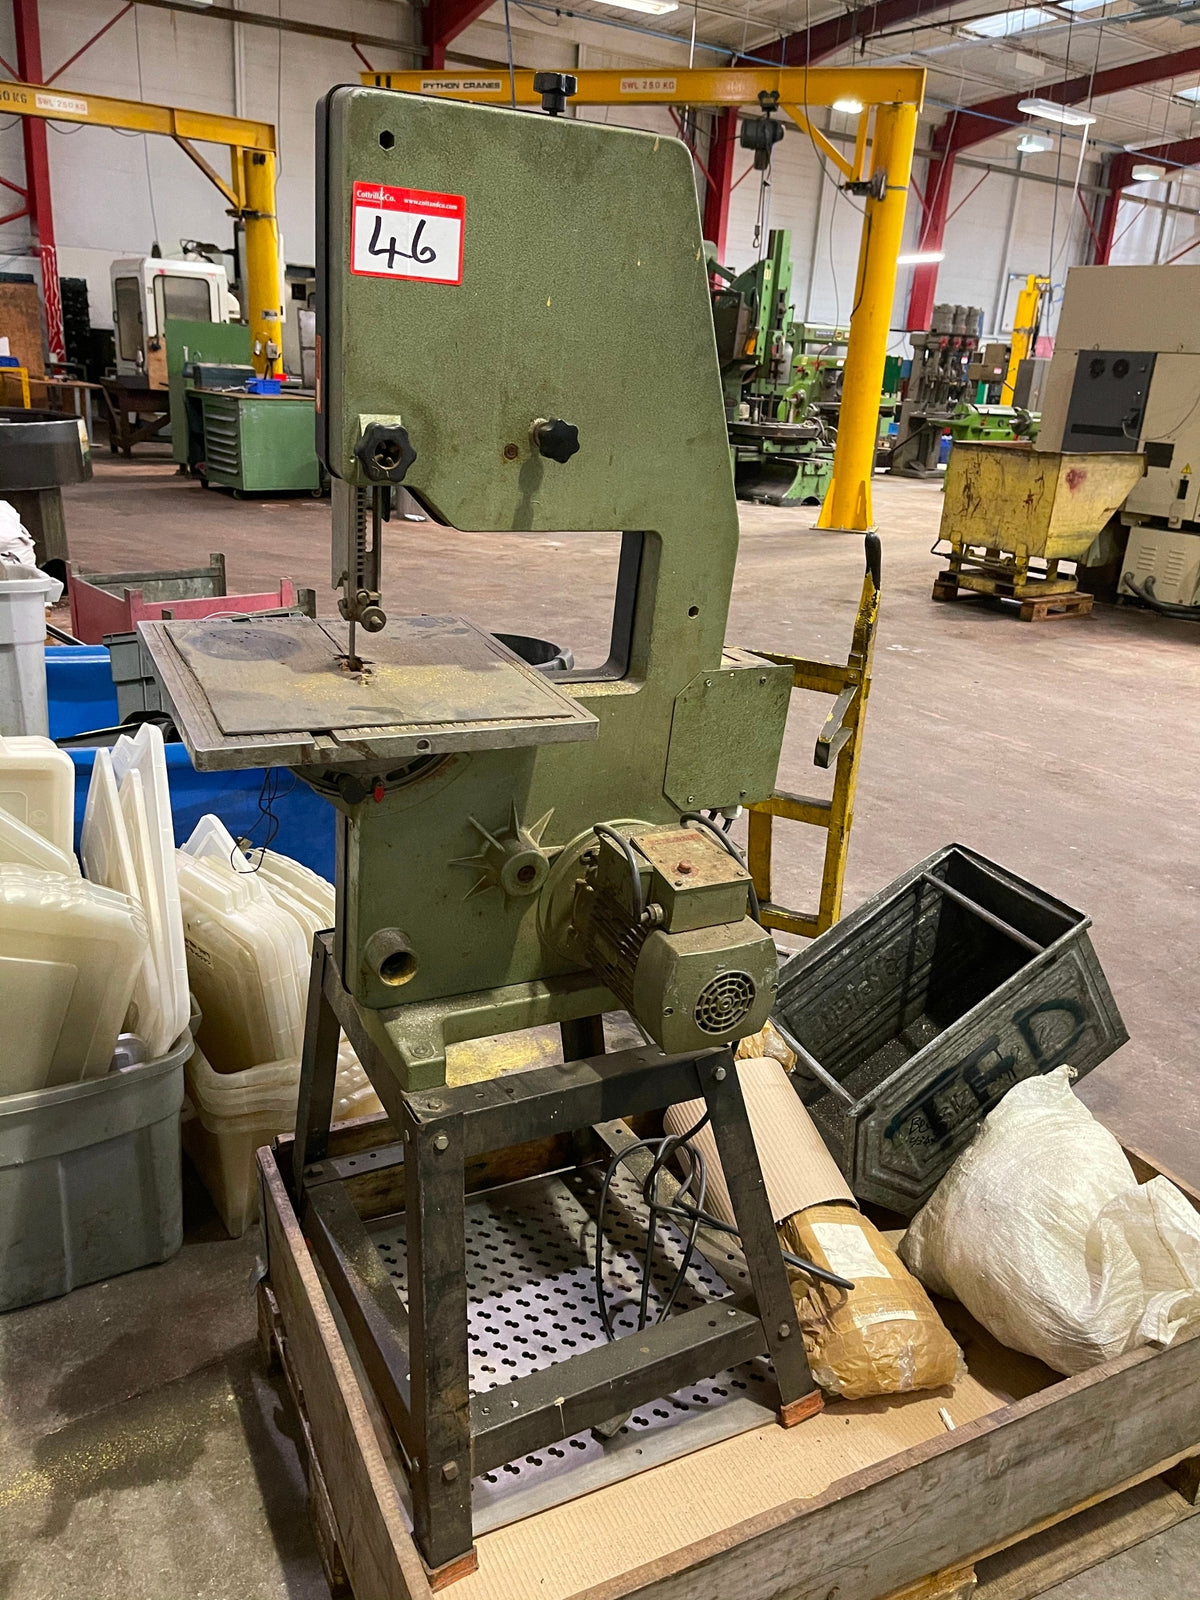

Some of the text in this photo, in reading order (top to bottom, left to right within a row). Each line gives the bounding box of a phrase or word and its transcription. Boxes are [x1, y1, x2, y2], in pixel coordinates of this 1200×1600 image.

[621, 80, 675, 90] SWL 250 KG
[12, 92, 27, 104] KG
[57, 99, 74, 109] 250
[368, 215, 437, 269] 46
